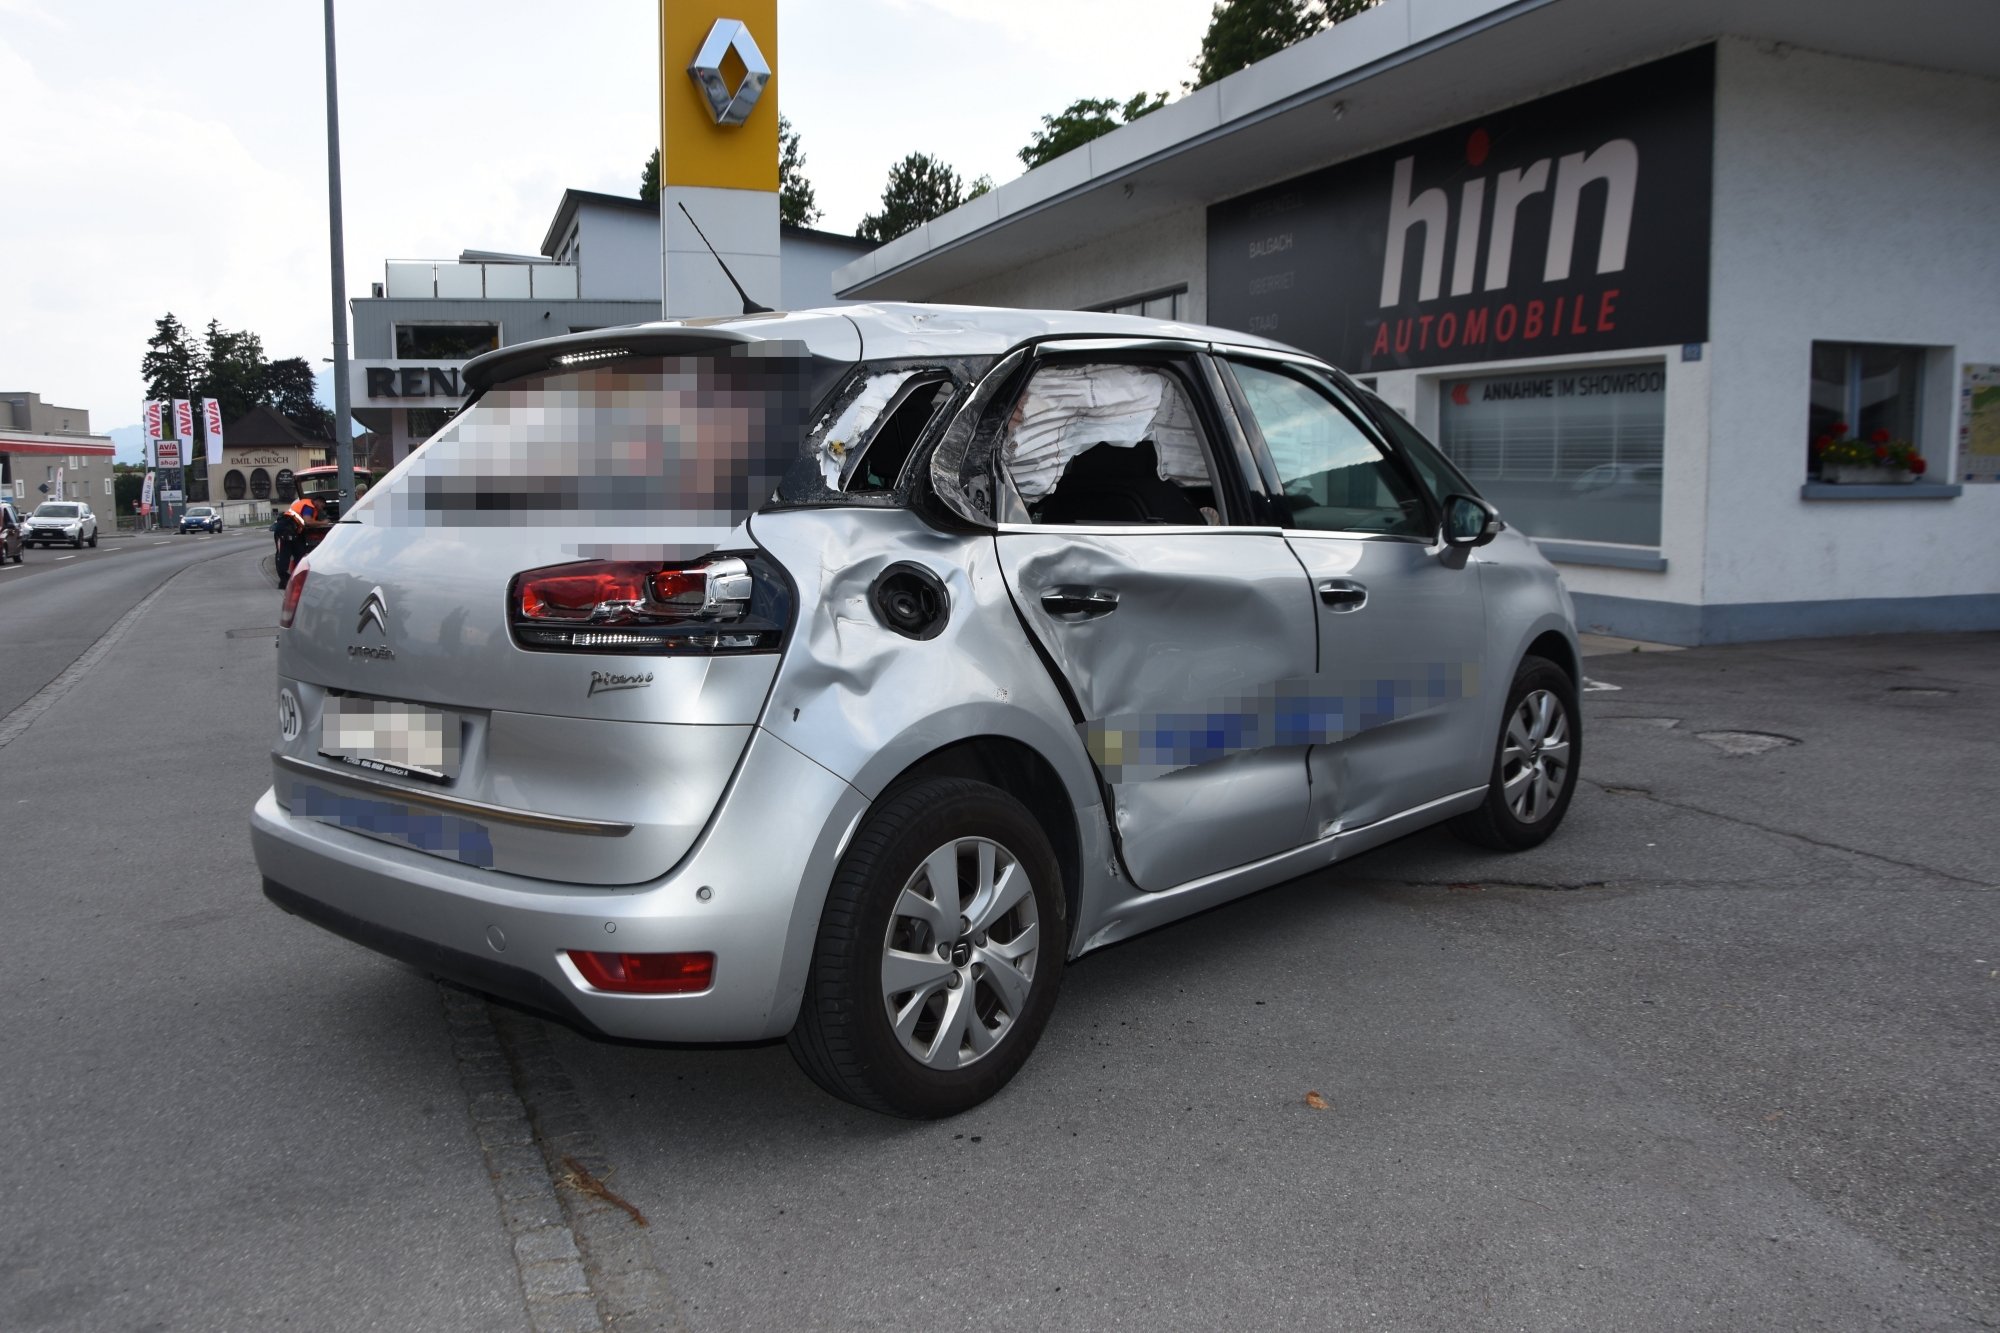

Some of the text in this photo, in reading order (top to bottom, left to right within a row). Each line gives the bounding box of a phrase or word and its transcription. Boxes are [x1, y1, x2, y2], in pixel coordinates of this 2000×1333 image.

[1379, 127, 1639, 309] hirn
[1249, 232, 1294, 259] BALGACH
[1249, 270, 1296, 296] OBERRIET
[1249, 313, 1279, 334] STAAD
[1372, 289, 1620, 357] AUTOMOBILE
[1482, 378, 1553, 402] ANNAHME
[1557, 377, 1575, 398] IM
[146, 403, 161, 438] AVIA
[176, 402, 192, 437] AVIA
[206, 401, 221, 435] AVIA
[159, 443, 178, 451] AVIA
[231, 456, 289, 465] EMIL NÜESCH
[587, 670, 654, 698] Picasso
[281, 693, 297, 736] CH
